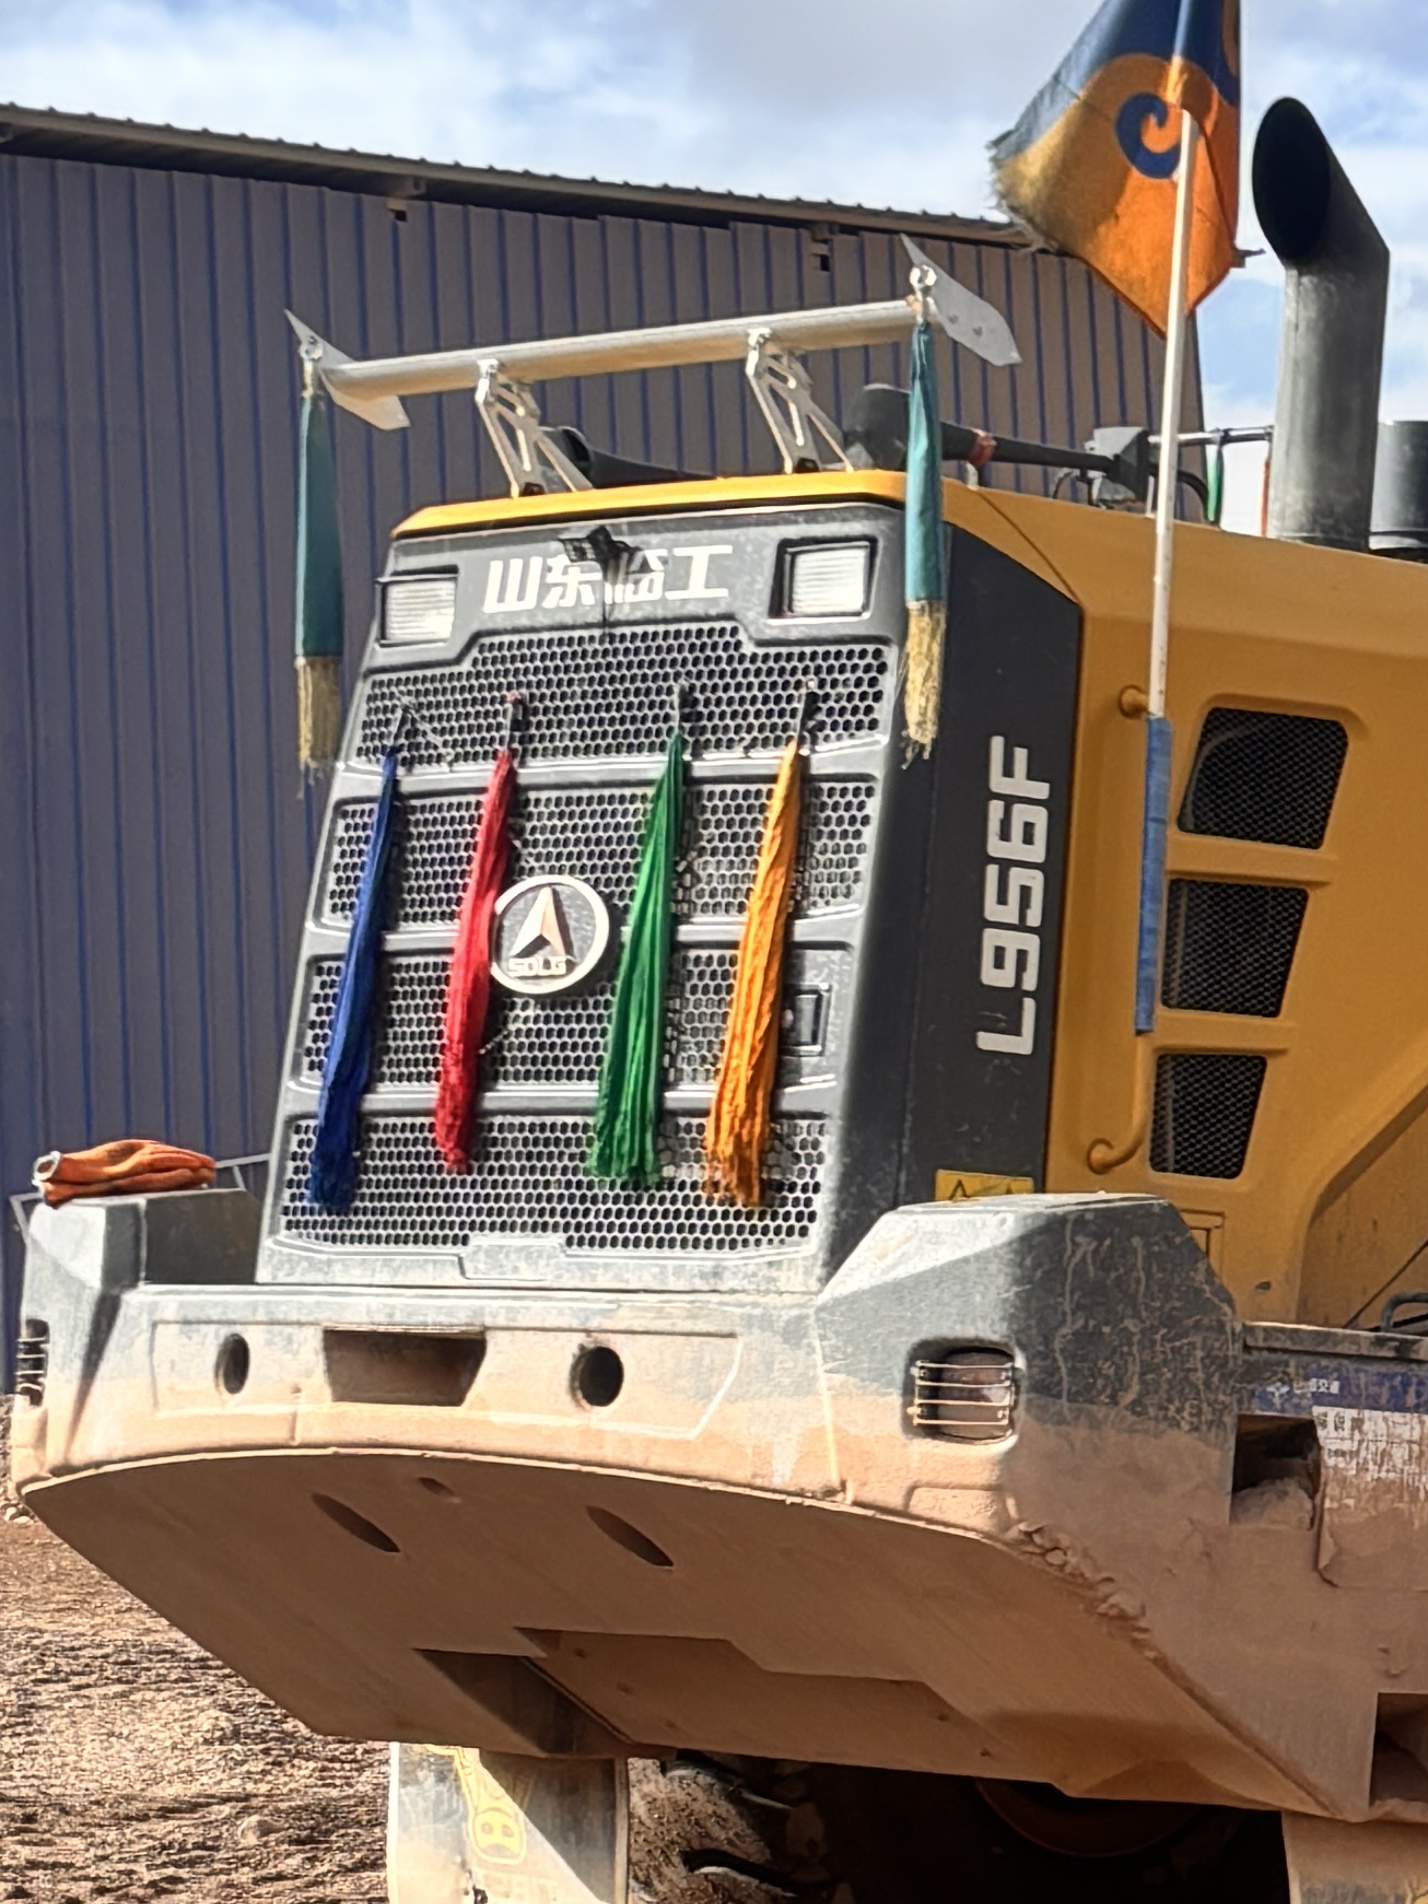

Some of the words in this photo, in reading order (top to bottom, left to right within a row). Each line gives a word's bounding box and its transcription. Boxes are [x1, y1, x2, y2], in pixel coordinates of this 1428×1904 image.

[483, 544, 733, 614] 山东临工
[976, 735, 1050, 1056] L956F
